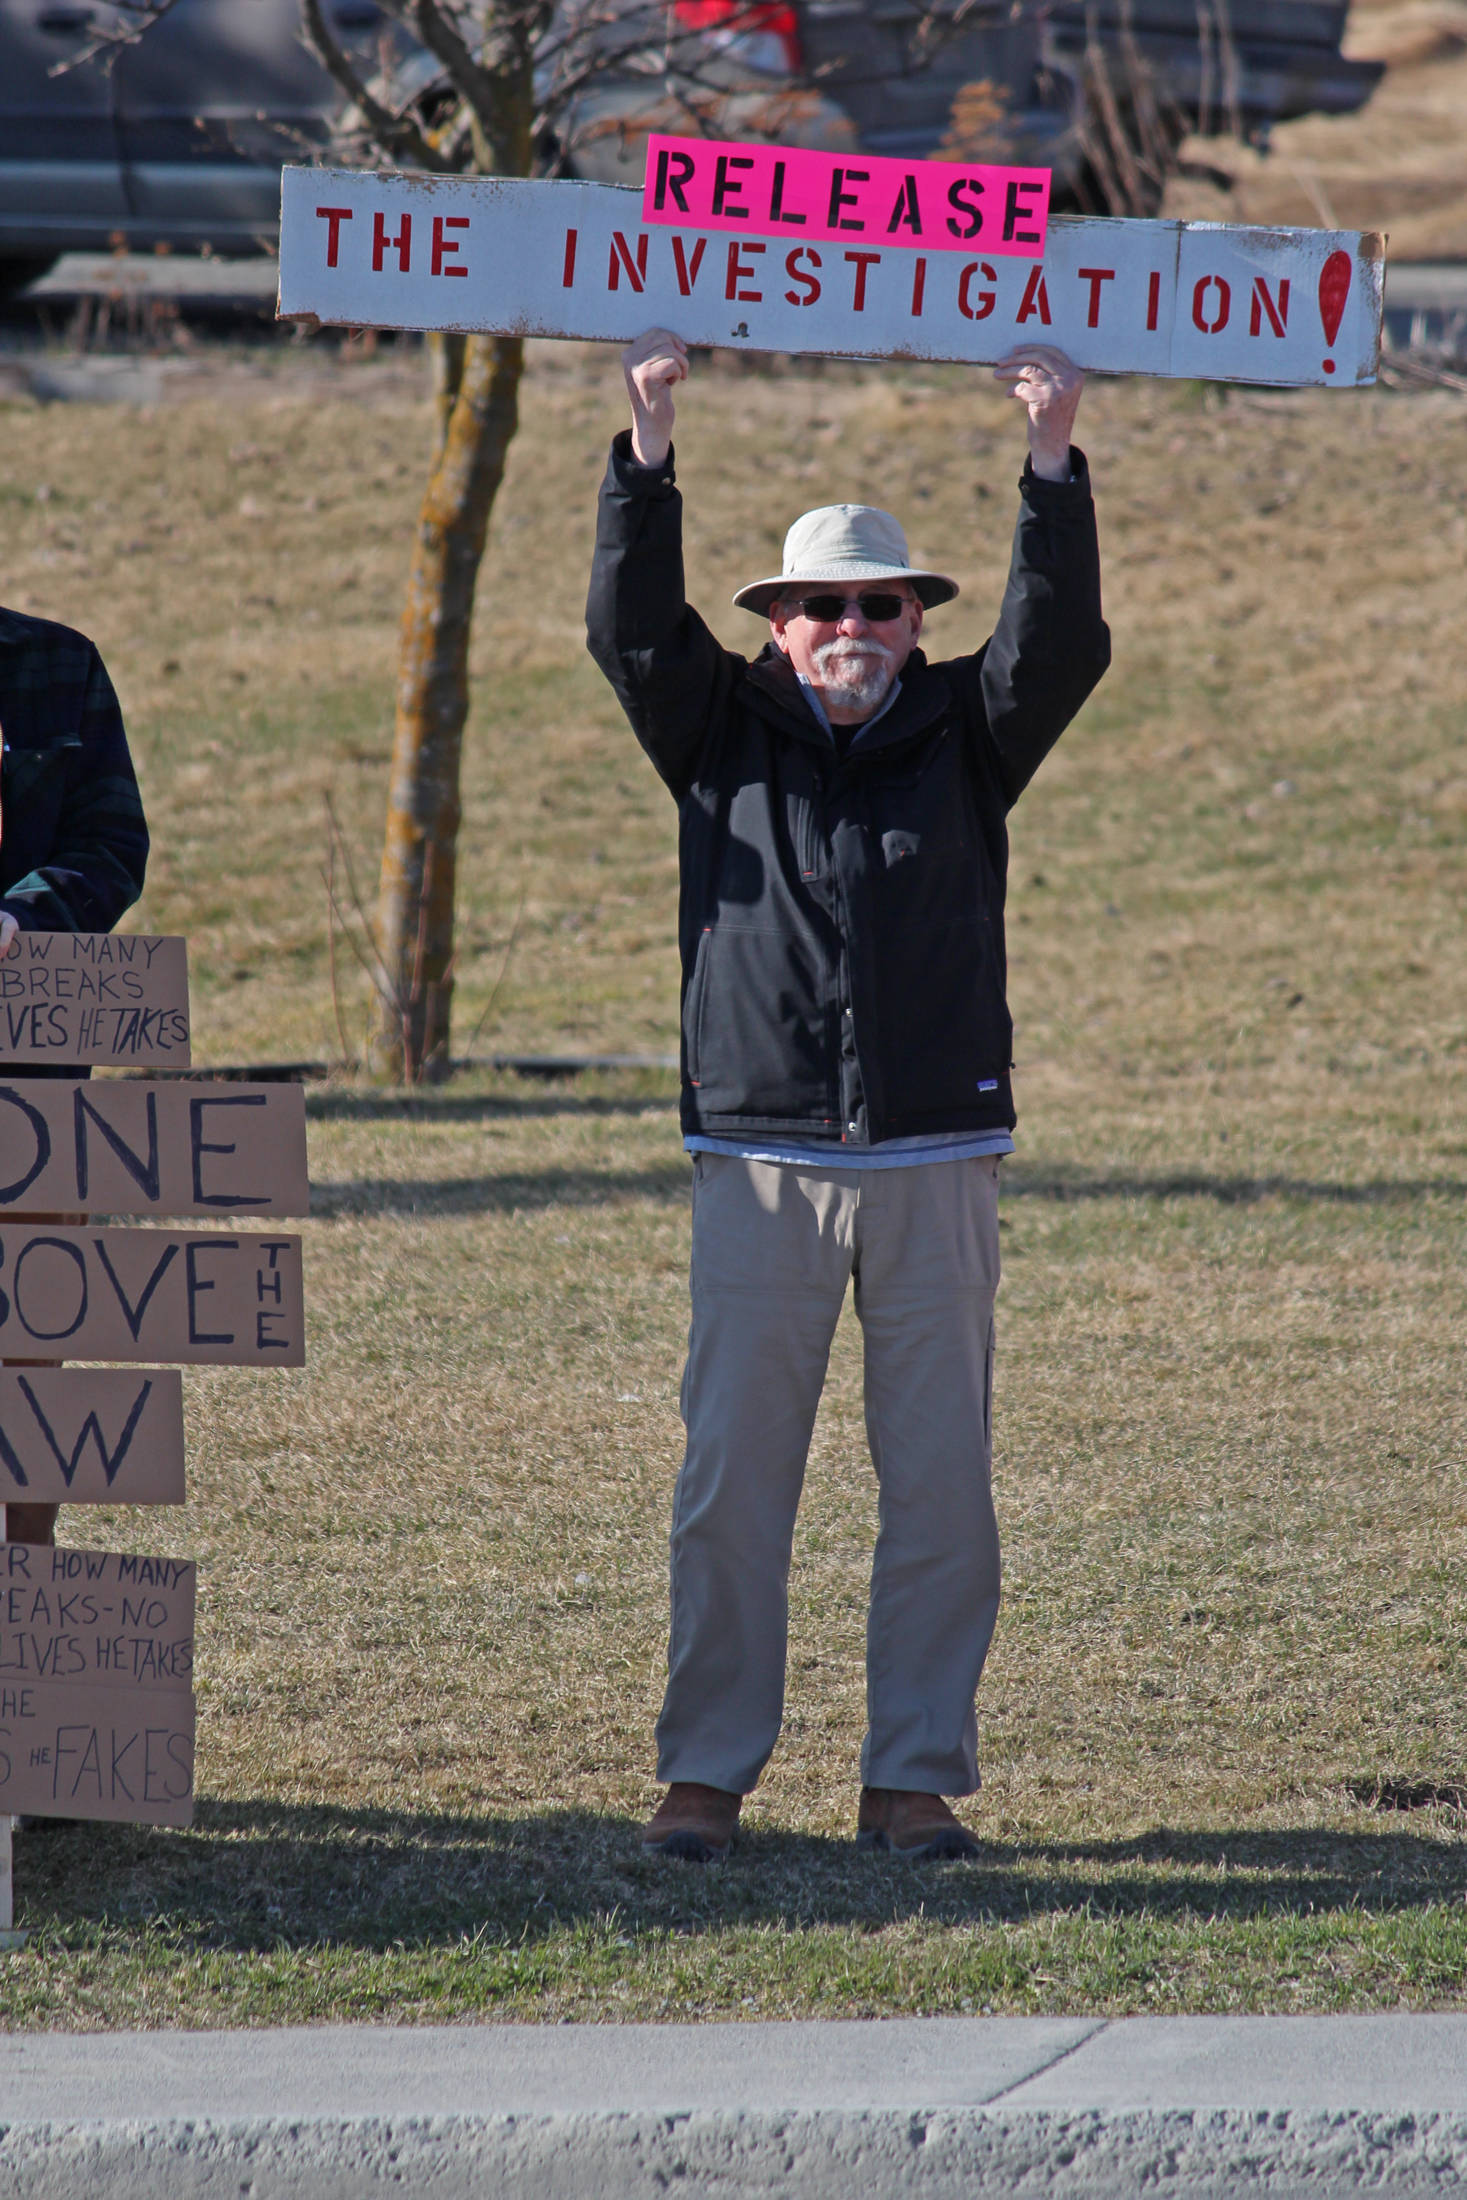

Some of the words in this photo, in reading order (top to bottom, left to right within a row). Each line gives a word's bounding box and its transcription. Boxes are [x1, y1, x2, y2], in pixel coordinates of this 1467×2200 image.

[654, 151, 1043, 244] RELEASE
[316, 207, 470, 278] THE
[563, 229, 1353, 375] INVESTIGATION!
[0, 967, 143, 1002] BREAKS
[1, 936, 54, 962] OW
[72, 935, 163, 968] MANY
[0, 1236, 240, 1345] OVE
[256, 1243, 291, 1349] THE
[0, 1546, 31, 1579] R
[51, 1551, 108, 1582] HOW
[118, 1555, 190, 1590] MANY
[29, 1746, 51, 1767] HE
[53, 1724, 192, 1803] FAKES
